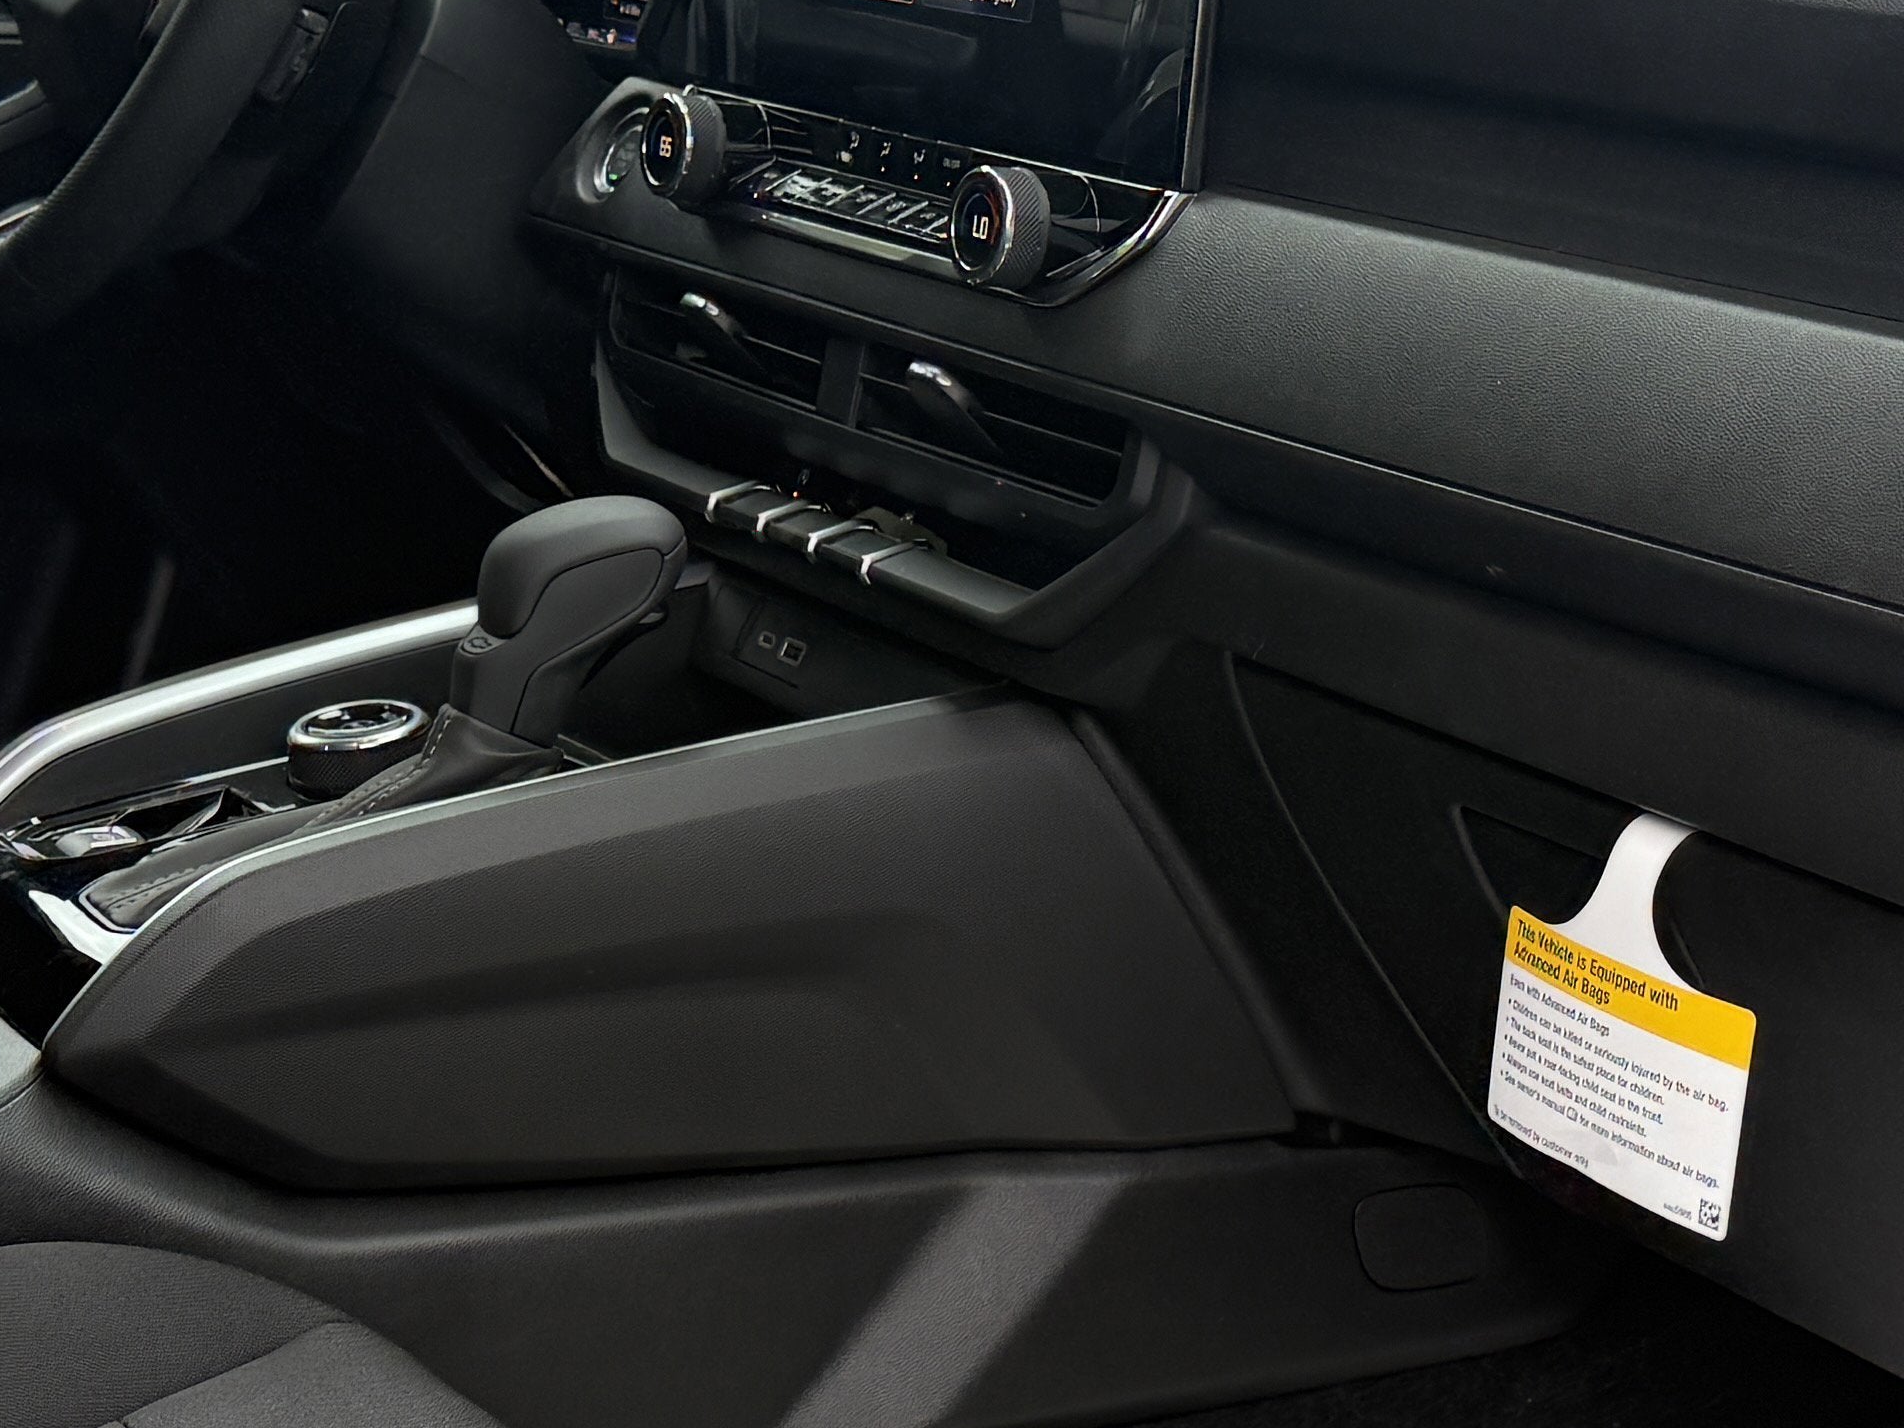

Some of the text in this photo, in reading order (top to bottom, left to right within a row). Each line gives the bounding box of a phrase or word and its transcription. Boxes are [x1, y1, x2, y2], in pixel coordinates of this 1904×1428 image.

[1513, 940, 1611, 1005] Advanced Air Bags
[1517, 918, 1536, 945] This
[1538, 930, 1574, 966] Vehicle
[1589, 958, 1647, 999] Equipped
[1648, 987, 1680, 1014] with
